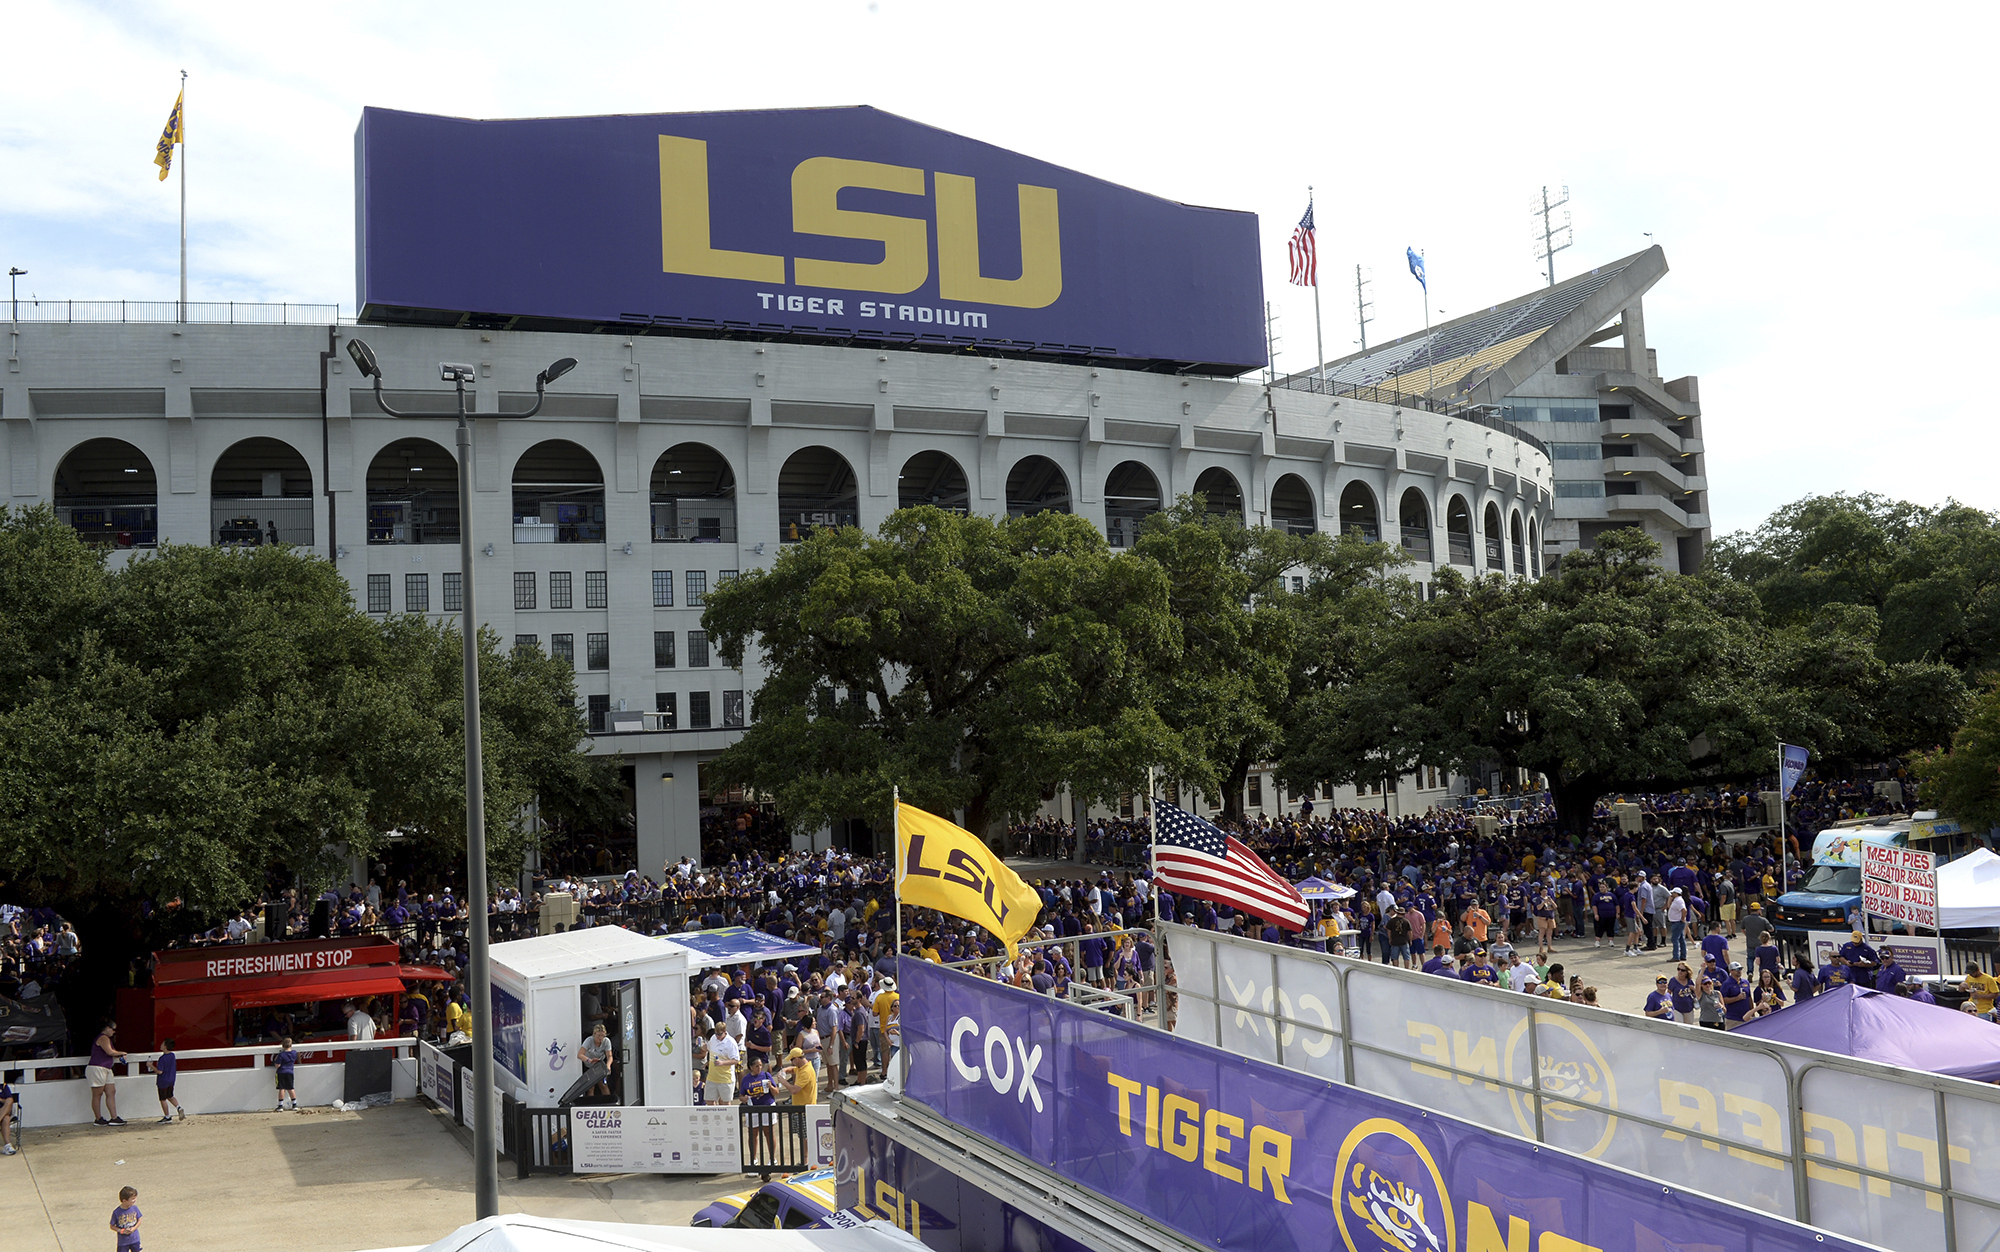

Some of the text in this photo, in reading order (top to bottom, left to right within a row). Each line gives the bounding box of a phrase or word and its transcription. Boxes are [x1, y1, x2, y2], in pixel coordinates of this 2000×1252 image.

[658, 134, 1062, 309] LSU
[757, 292, 988, 329] TIGER STADIUM
[800, 512, 837, 526] LSU
[411, 555, 422, 563] 18
[1486, 547, 1497, 558] LSU
[1866, 846, 1930, 870] MEAT PIES
[907, 834, 1010, 927] LSU
[1864, 861, 1934, 889] ALLIGATOR BALLS
[1418, 898, 1426, 911] 7
[1865, 879, 1935, 907] BOUDIN BALLS
[1864, 896, 1934, 926] RED BEANS & RICE
[206, 949, 353, 977] REFRESHMENT STOP
[1473, 969, 1491, 977] LSU
[950, 1015, 1044, 1114] COX
[693, 1092, 699, 1103] 9
[575, 1110, 613, 1120] GEAUX
[586, 1119, 622, 1128] CLEAR
[1107, 1070, 1293, 1205] TIGER
[853, 1165, 920, 1241] LSU
